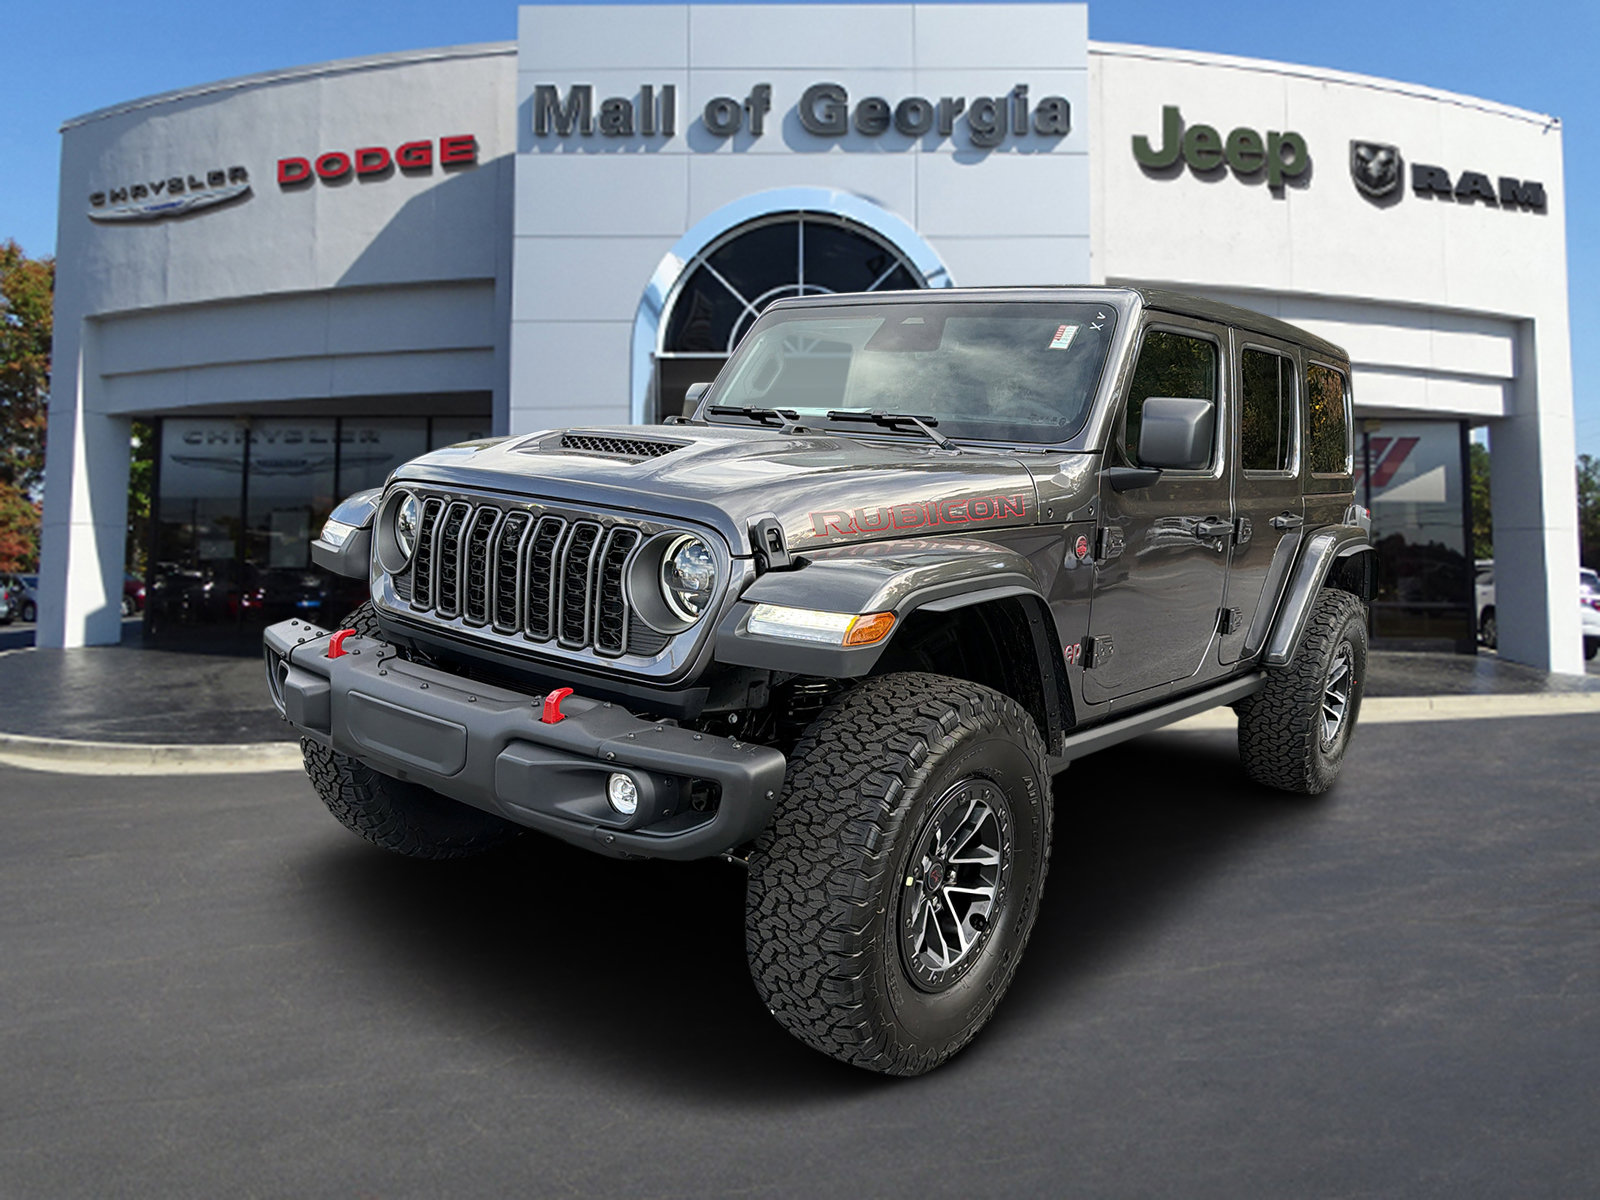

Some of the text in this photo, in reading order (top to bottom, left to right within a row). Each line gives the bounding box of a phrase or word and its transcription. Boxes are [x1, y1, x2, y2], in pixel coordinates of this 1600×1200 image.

[532, 82, 1072, 149] Mall of Georgia
[277, 134, 476, 185] DODGE
[1131, 105, 1310, 194] Jeep
[89, 166, 249, 208] CHRYSLER
[1411, 163, 1546, 214] RAM
[183, 430, 380, 444] CHRYSLER
[809, 495, 1025, 536] RUBICON
[1064, 643, 1081, 665] ep
